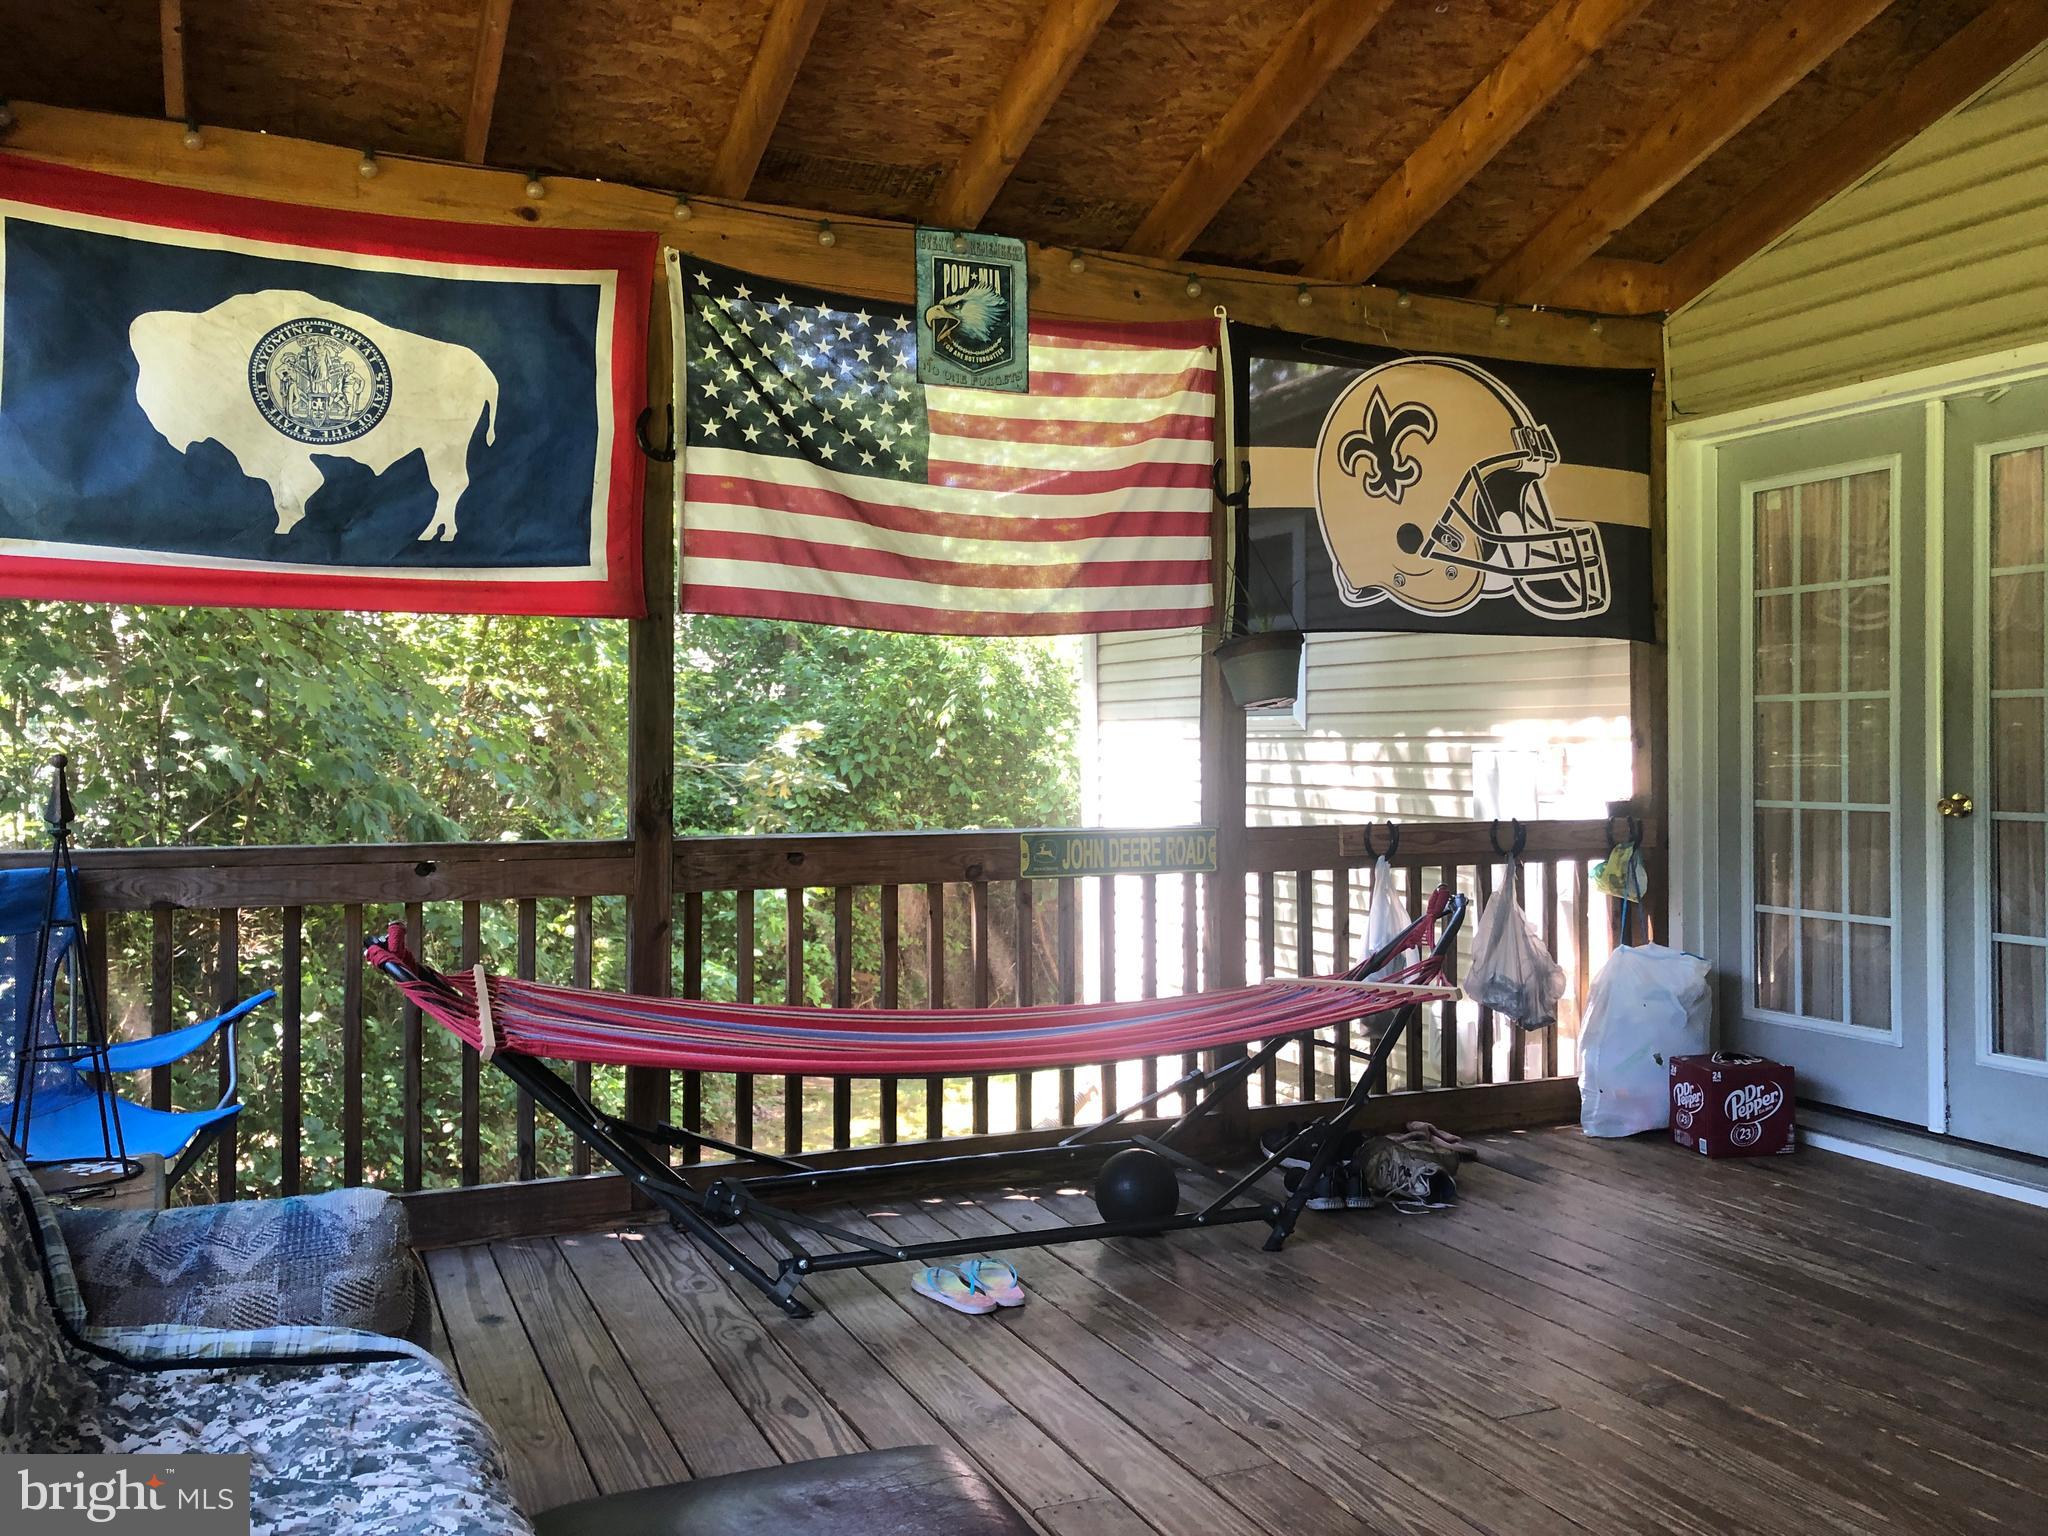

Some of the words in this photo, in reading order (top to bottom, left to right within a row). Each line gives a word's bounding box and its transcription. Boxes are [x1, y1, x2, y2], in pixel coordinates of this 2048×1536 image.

[943, 263, 970, 298] POW
[979, 267, 1001, 294] MIA
[256, 325, 313, 374] WYOMING
[330, 328, 379, 363] GREAT
[975, 347, 1005, 363] FORGOTTEN
[258, 384, 269, 400] OF
[375, 372, 384, 409] SEAL
[268, 407, 311, 437] STATE
[321, 426, 354, 438] THE
[359, 413, 372, 427] OF
[1062, 839, 1105, 870] JOHN
[1109, 837, 1161, 868] DEERE
[1165, 835, 1208, 867] ROAD
[1712, 1071, 1722, 1080] 24
[1674, 1082, 1702, 1109] Pepper
[1682, 1082, 1694, 1096] Dr
[1744, 1084, 1764, 1108] Dr
[1725, 1089, 1779, 1121] Pepper
[1680, 1114, 1688, 1124] 23
[1739, 1127, 1752, 1140] 23
